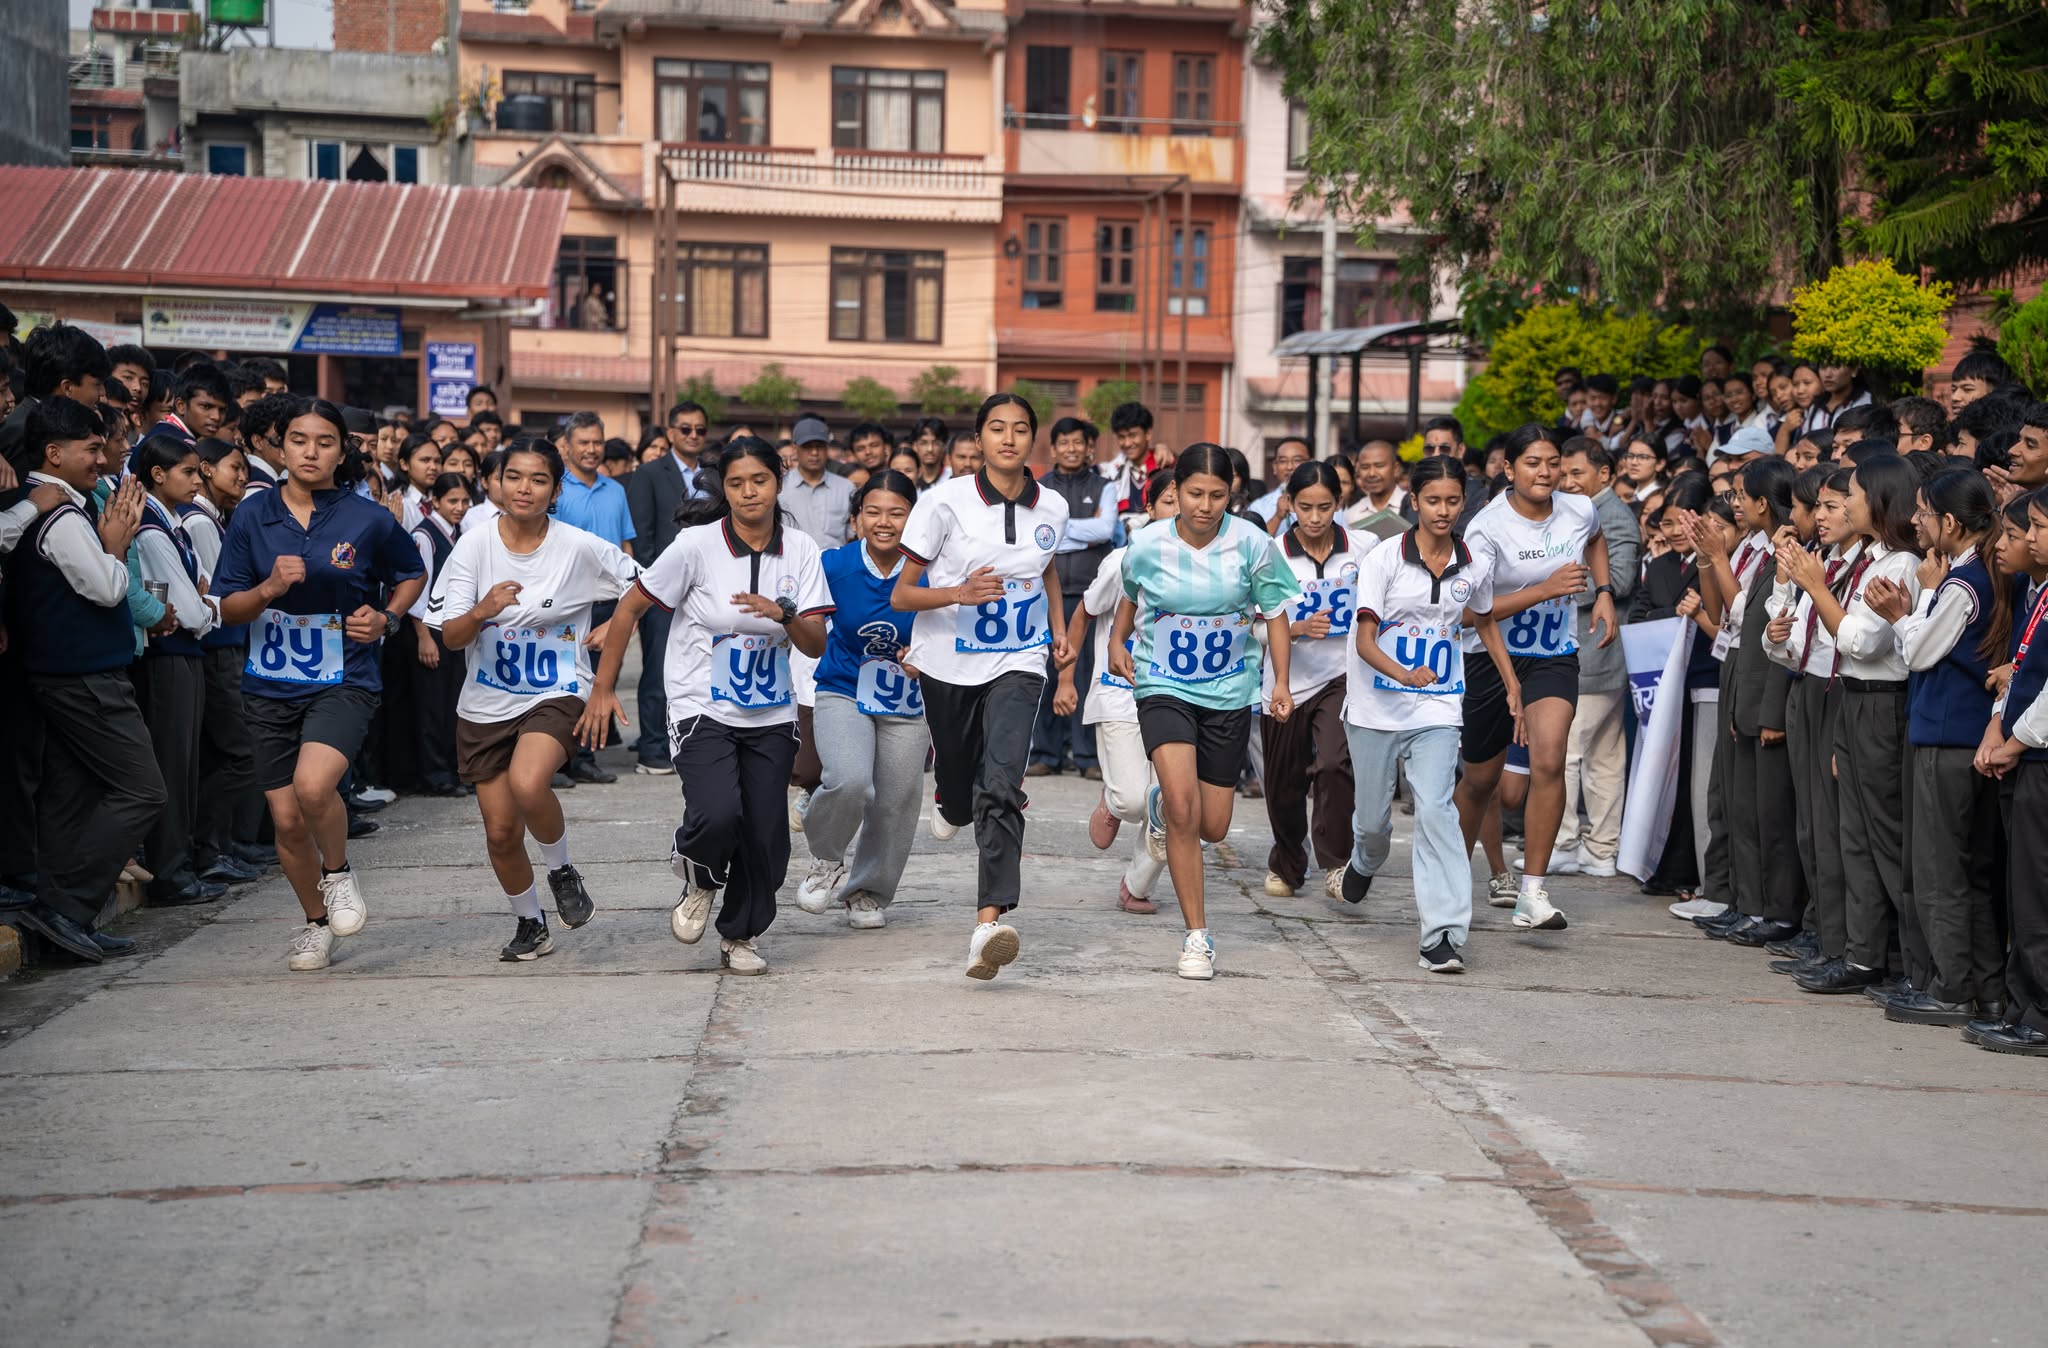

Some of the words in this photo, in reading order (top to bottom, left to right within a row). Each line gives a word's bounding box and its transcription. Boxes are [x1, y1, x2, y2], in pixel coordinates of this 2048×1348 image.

[260, 622, 324, 679] ४५
[495, 640, 559, 688] ४७
[729, 647, 777, 703] ५५
[1168, 629, 1233, 675] ४४
